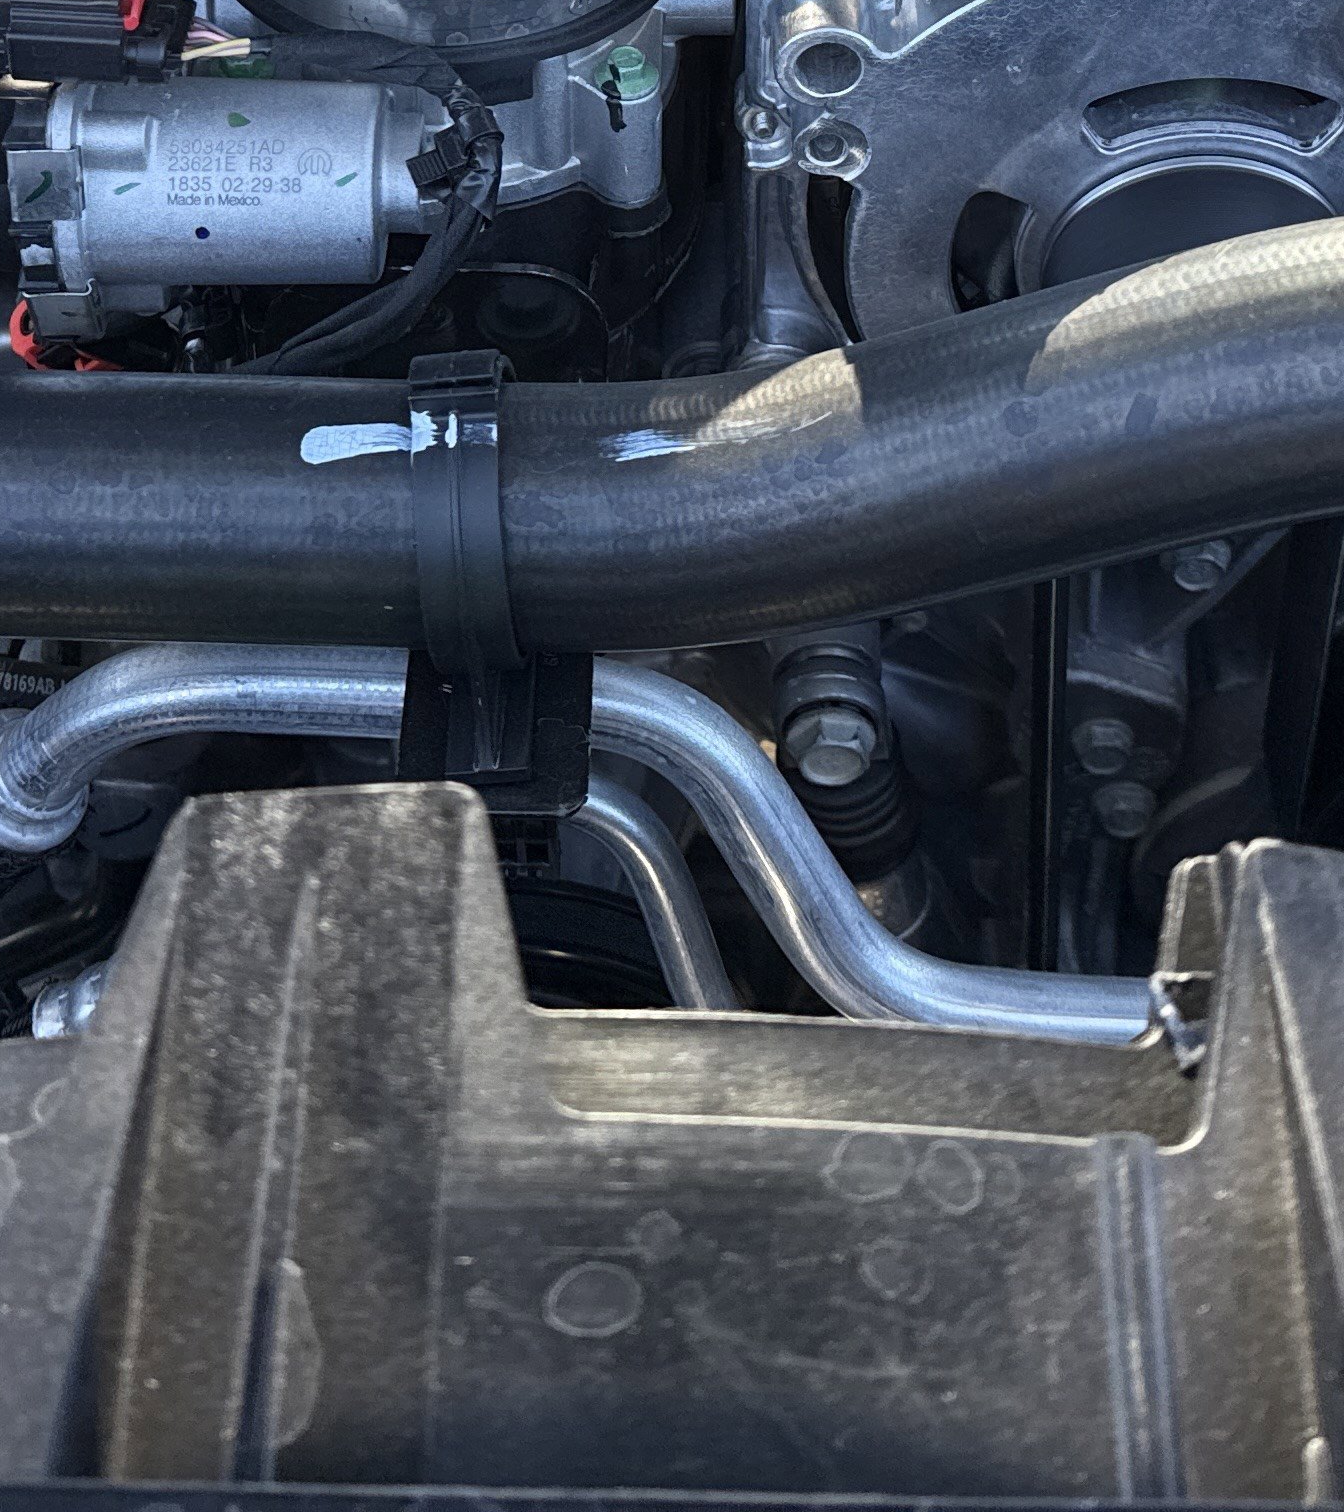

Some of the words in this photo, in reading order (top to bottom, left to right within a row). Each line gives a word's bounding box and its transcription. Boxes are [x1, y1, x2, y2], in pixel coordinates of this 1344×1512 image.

[167, 156, 237, 172] 23621E
[248, 156, 273, 172] R3
[168, 176, 212, 192] 1835
[221, 177, 303, 194] 02:29:38
[167, 193, 202, 206] Made
[204, 194, 215, 206] in
